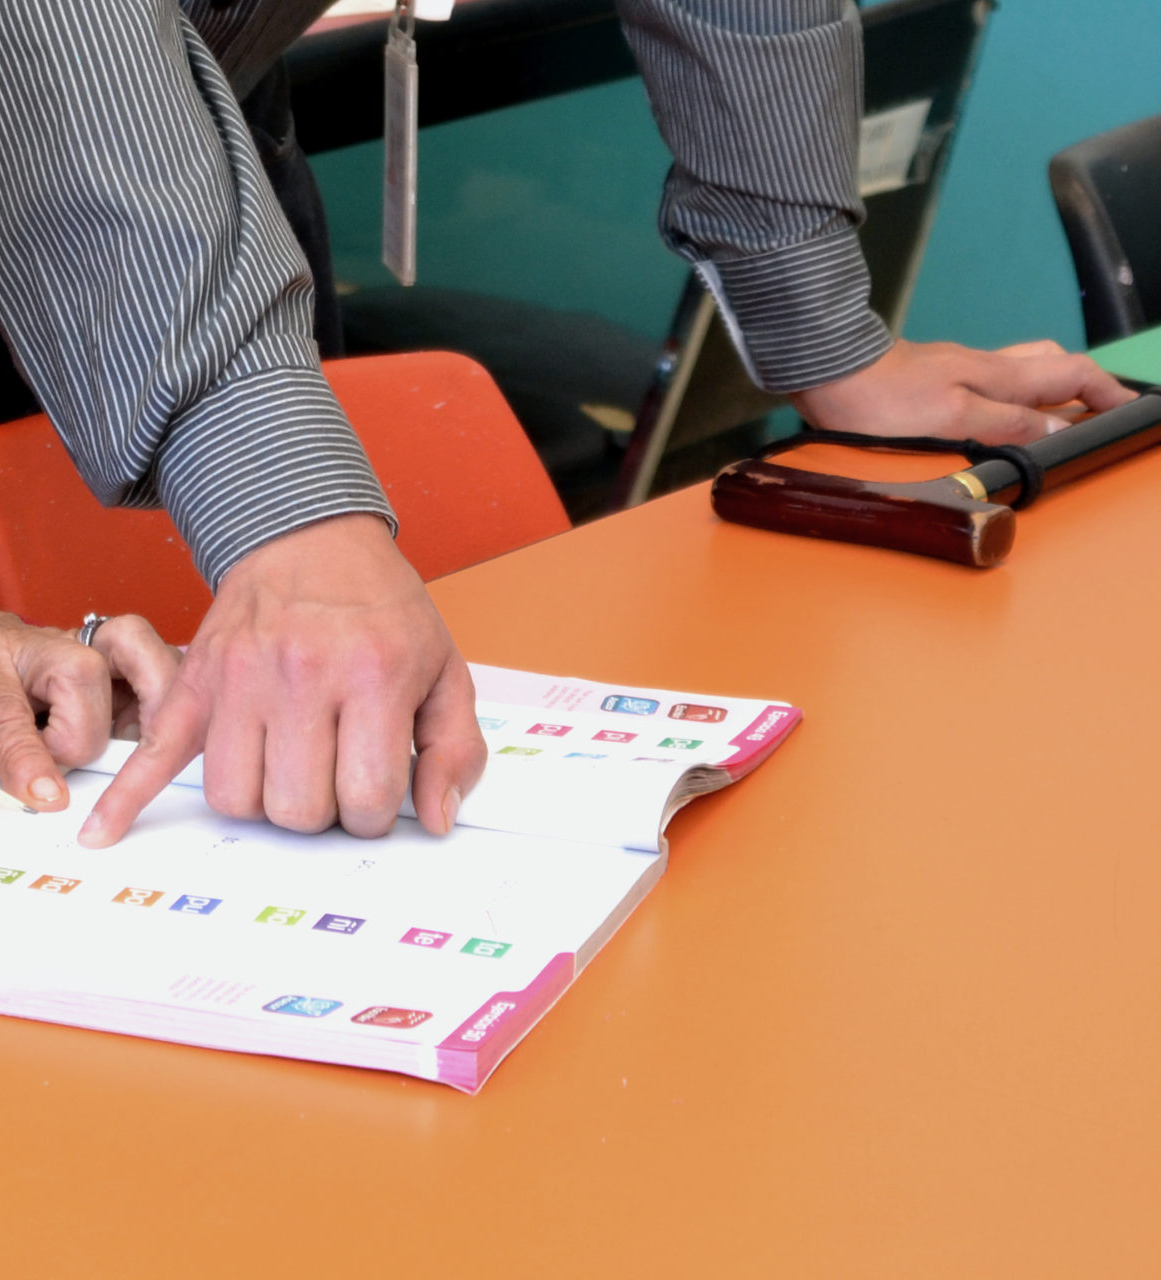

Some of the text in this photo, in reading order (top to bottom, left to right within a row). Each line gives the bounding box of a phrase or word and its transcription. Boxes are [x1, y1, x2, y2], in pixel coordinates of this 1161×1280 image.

[123, 888, 154, 906] po
[181, 895, 211, 914] pu
[413, 931, 444, 945] te
[461, 1002, 516, 1041] Ejercicio 50
